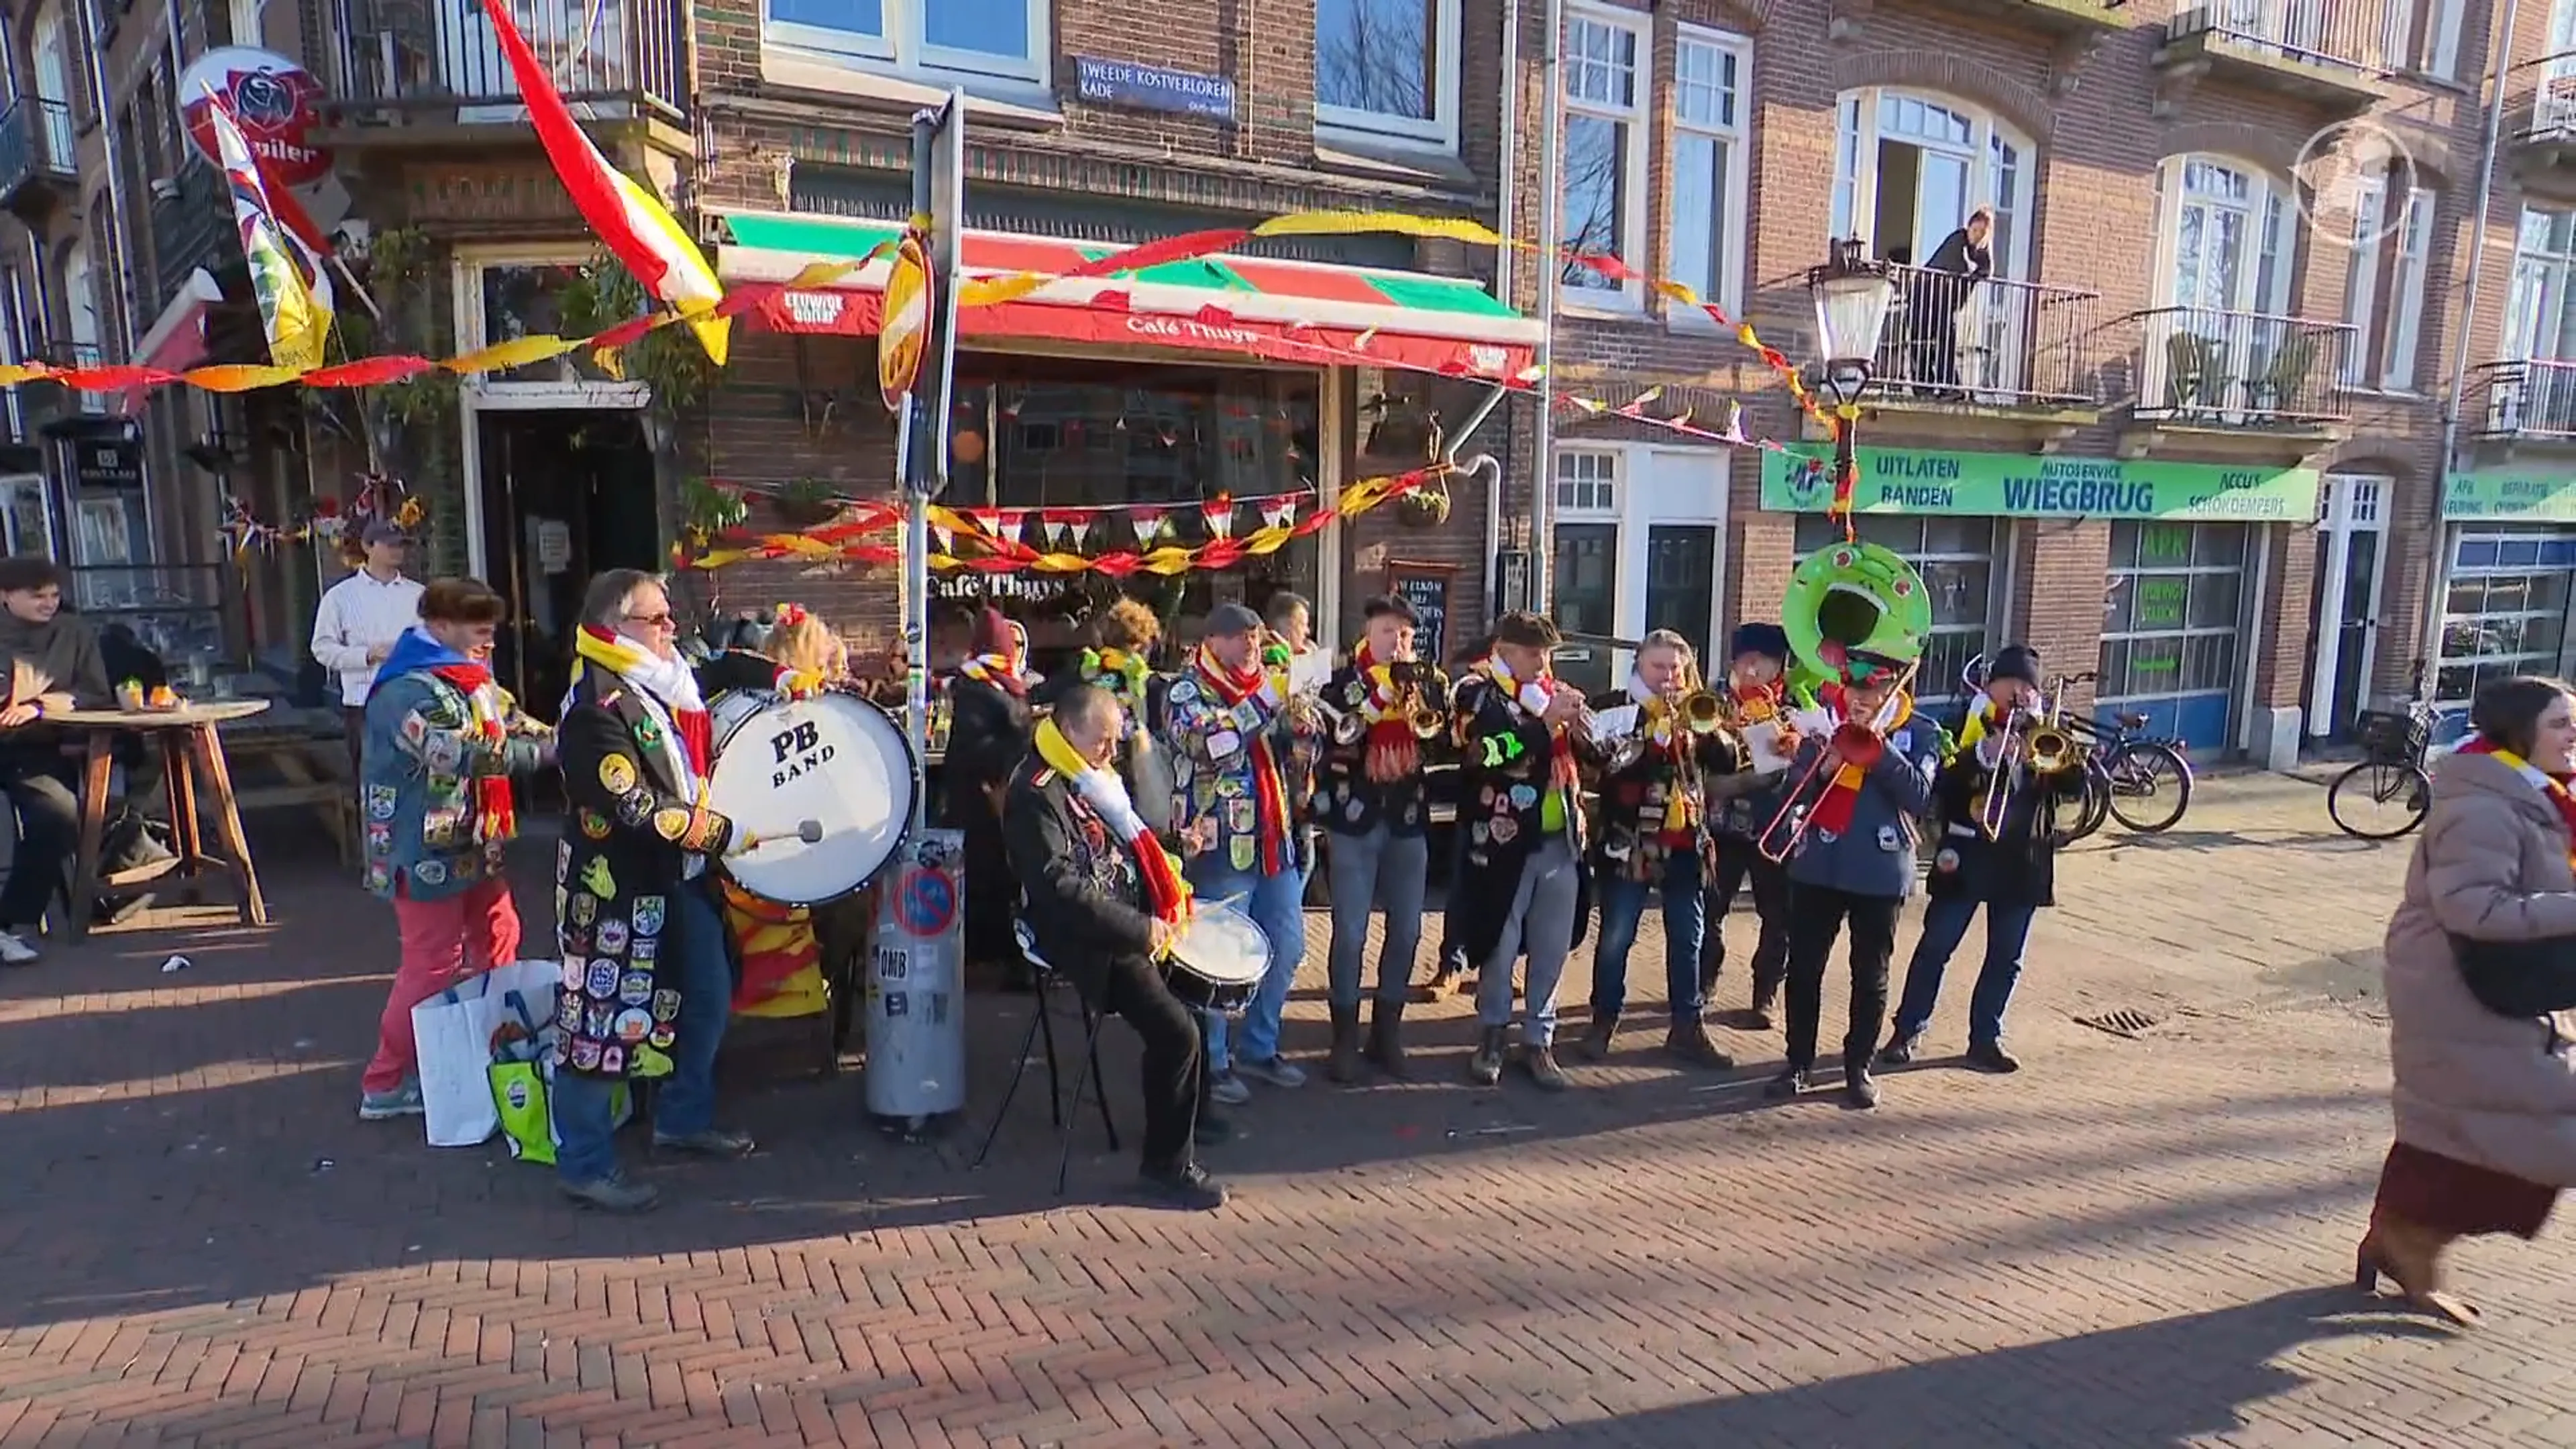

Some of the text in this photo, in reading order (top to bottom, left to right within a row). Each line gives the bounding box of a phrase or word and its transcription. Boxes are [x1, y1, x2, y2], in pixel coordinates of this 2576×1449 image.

[1081, 63, 1230, 98] TWEEDE KOSTVERLOREN
[1081, 80, 1114, 98] KADE
[1126, 316, 1179, 335] Café
[1876, 456, 1960, 479] UITLATEN
[2041, 460, 2122, 479] AUTOSERVICE
[1881, 484, 1953, 506] RANDEN
[2003, 478, 2153, 513] WIEGBRUG
[771, 720, 819, 763] PB
[773, 745, 835, 789] BAND
